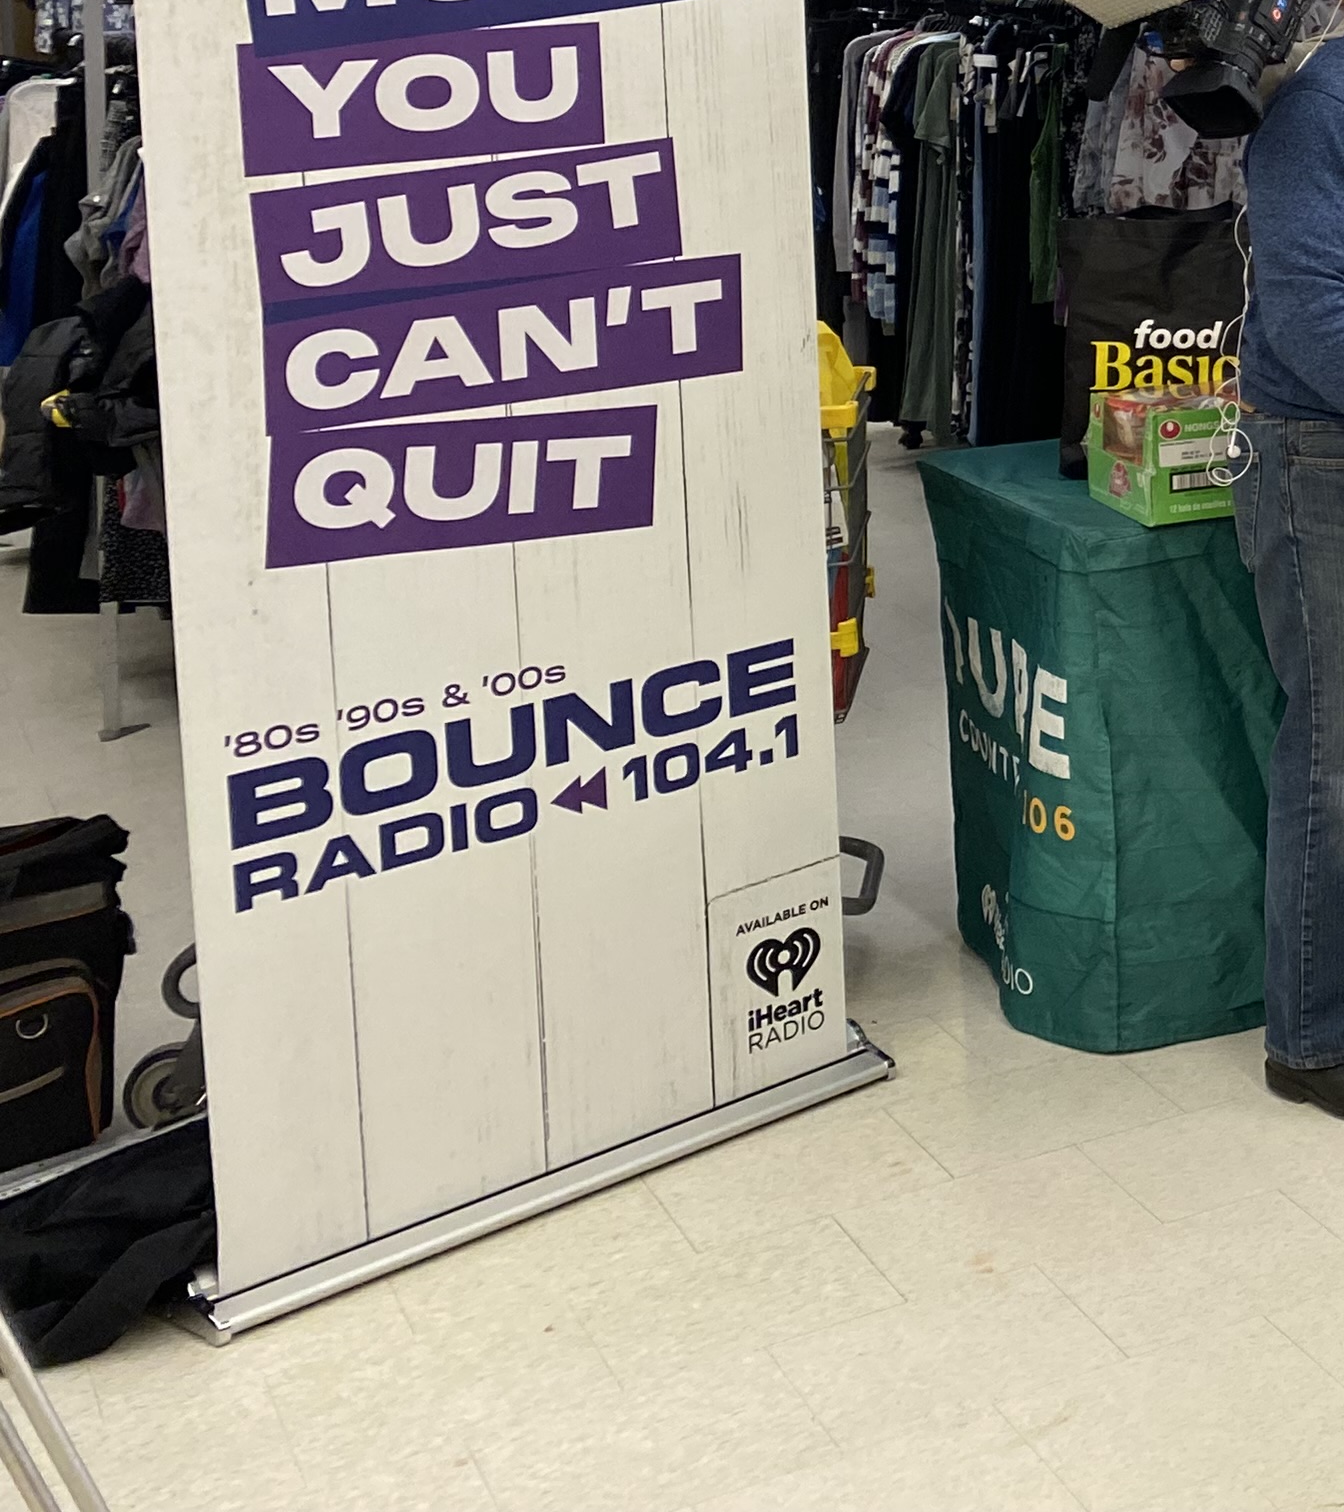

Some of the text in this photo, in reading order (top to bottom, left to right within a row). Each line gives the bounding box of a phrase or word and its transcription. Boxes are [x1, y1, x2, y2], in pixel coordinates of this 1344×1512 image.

[268, 46, 579, 139] YOU
[280, 152, 663, 287] JUST
[285, 278, 724, 411] CAN'T
[1133, 319, 1223, 349] food
[1185, 420, 1222, 432] NONGS
[293, 435, 633, 530] QUIT
[224, 723, 320, 757] '80s
[337, 696, 425, 731] '90s
[442, 684, 470, 709] &
[227, 638, 798, 850] BOUNCE
[233, 714, 799, 914] RADIO 104.1
[736, 896, 829, 937] AVAILABLE ON
[748, 988, 823, 1032] iHeart
[749, 1010, 825, 1054] RADIO
